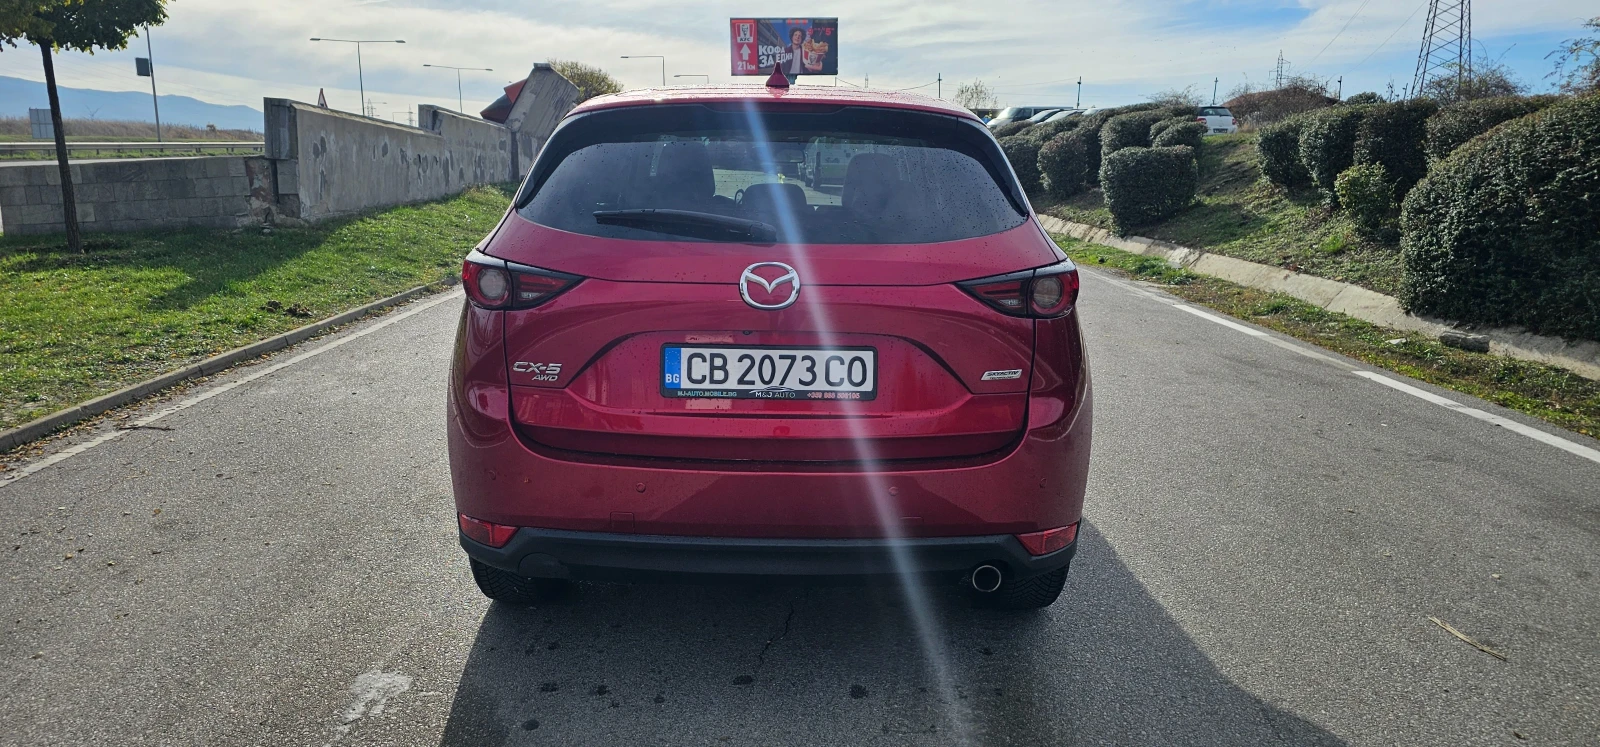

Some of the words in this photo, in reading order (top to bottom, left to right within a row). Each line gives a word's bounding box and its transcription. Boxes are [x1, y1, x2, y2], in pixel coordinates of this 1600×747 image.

[758, 44, 786, 56] КОФА
[737, 61, 747, 70] 21
[758, 56, 774, 68] ЗА
[512, 361, 563, 374] CX-5
[686, 352, 729, 385] CB
[736, 353, 817, 388] 2073
[824, 355, 868, 388] CO
[531, 374, 558, 382] AWD
[665, 373, 680, 383] BG
[774, 391, 796, 399] AUTO
